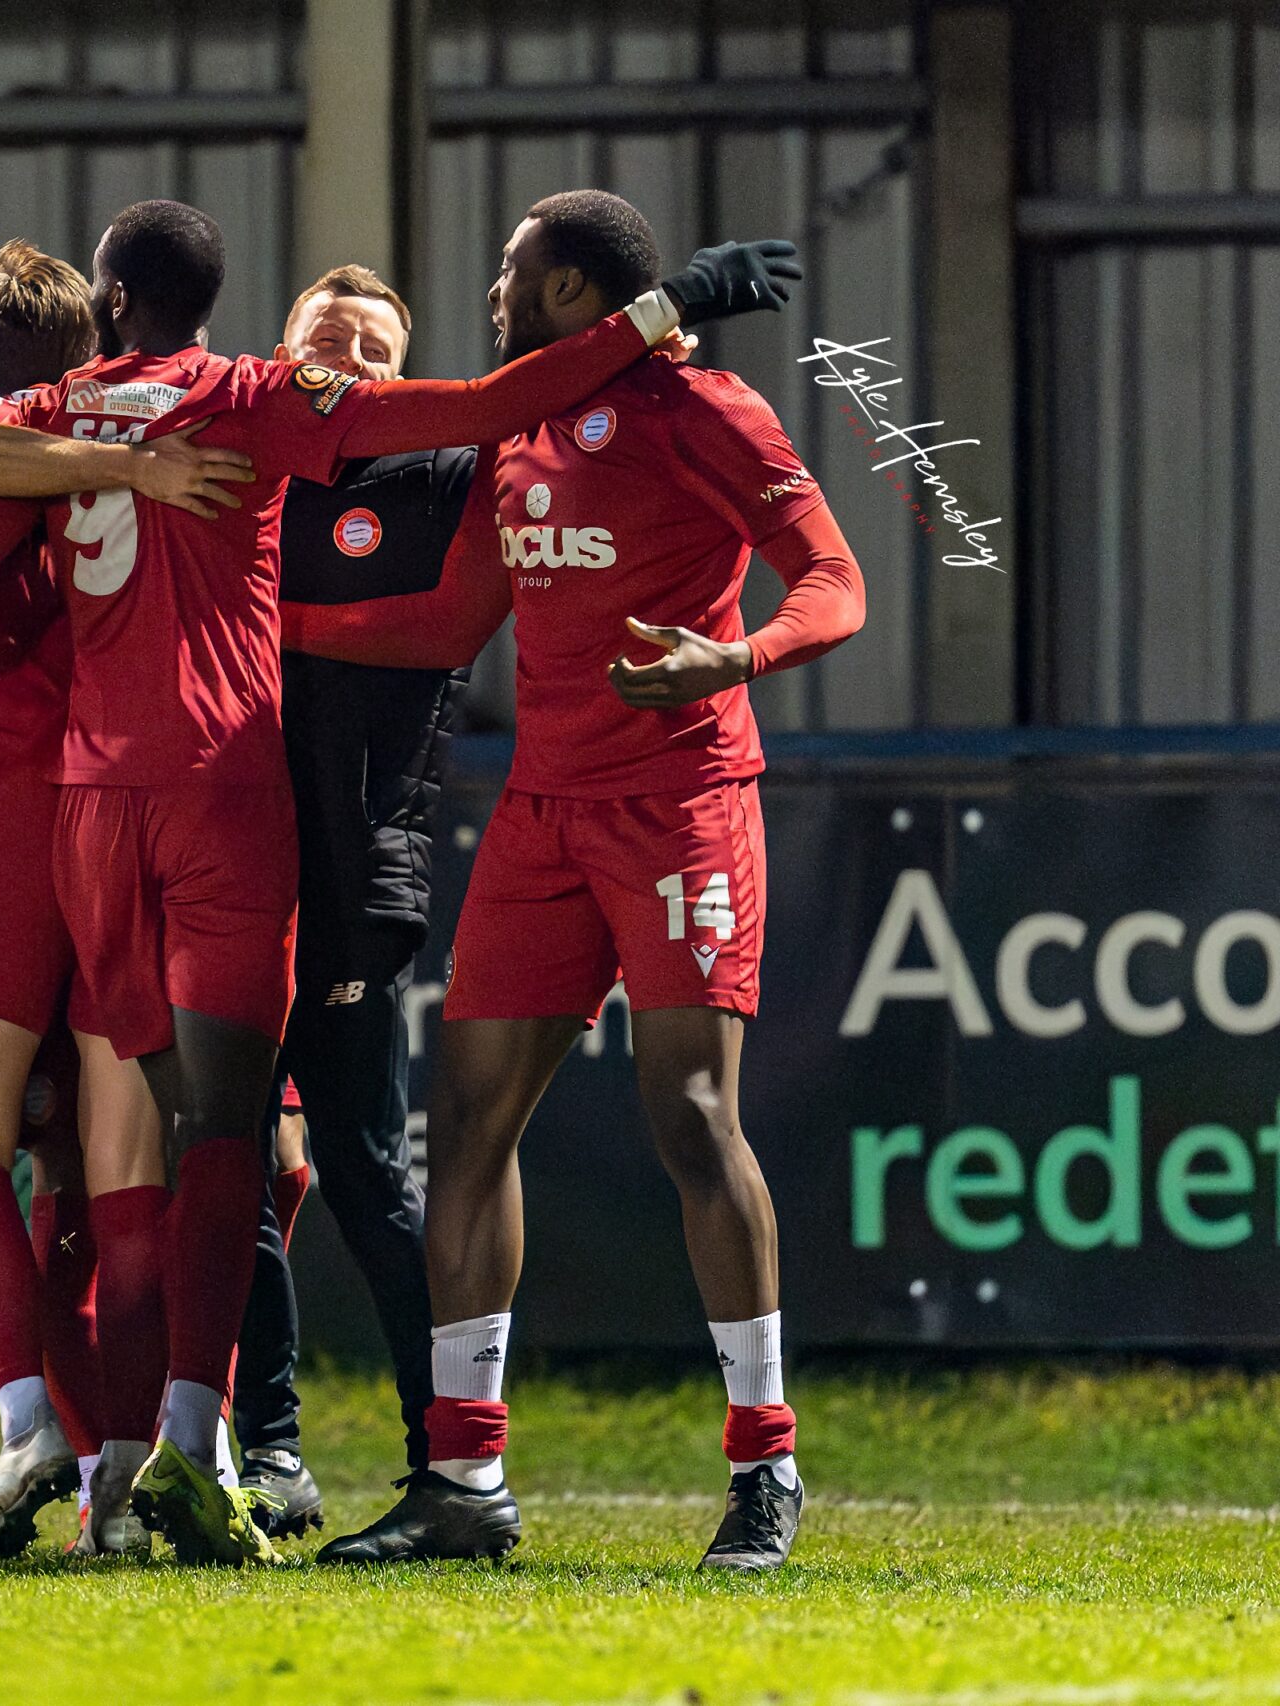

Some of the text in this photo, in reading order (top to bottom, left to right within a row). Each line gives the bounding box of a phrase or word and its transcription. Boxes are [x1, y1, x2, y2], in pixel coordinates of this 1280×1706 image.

[64, 487, 138, 596] 9
[495, 513, 617, 569] ocus
[656, 872, 736, 940] 14
